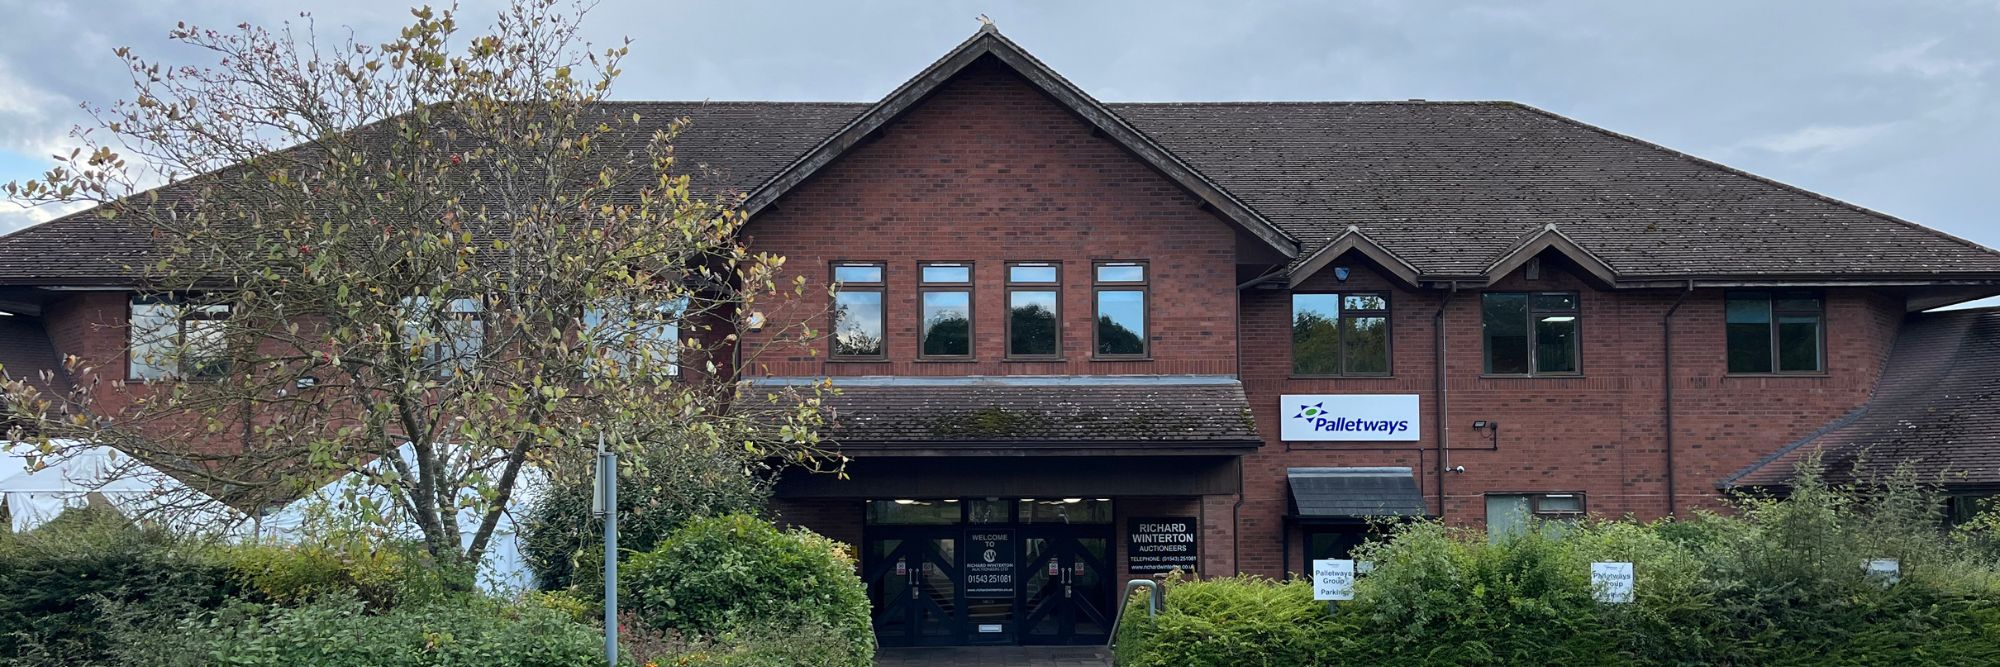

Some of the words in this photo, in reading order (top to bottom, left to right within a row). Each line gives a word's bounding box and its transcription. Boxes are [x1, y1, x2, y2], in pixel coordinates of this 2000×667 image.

[1315, 417, 1408, 435] Palletways
[1140, 523, 1186, 532] RICHARD
[1132, 533, 1194, 543] WINTERTON
[1315, 569, 1353, 578] Palletways
[967, 574, 988, 583] 01543
[1322, 577, 1345, 585] Group
